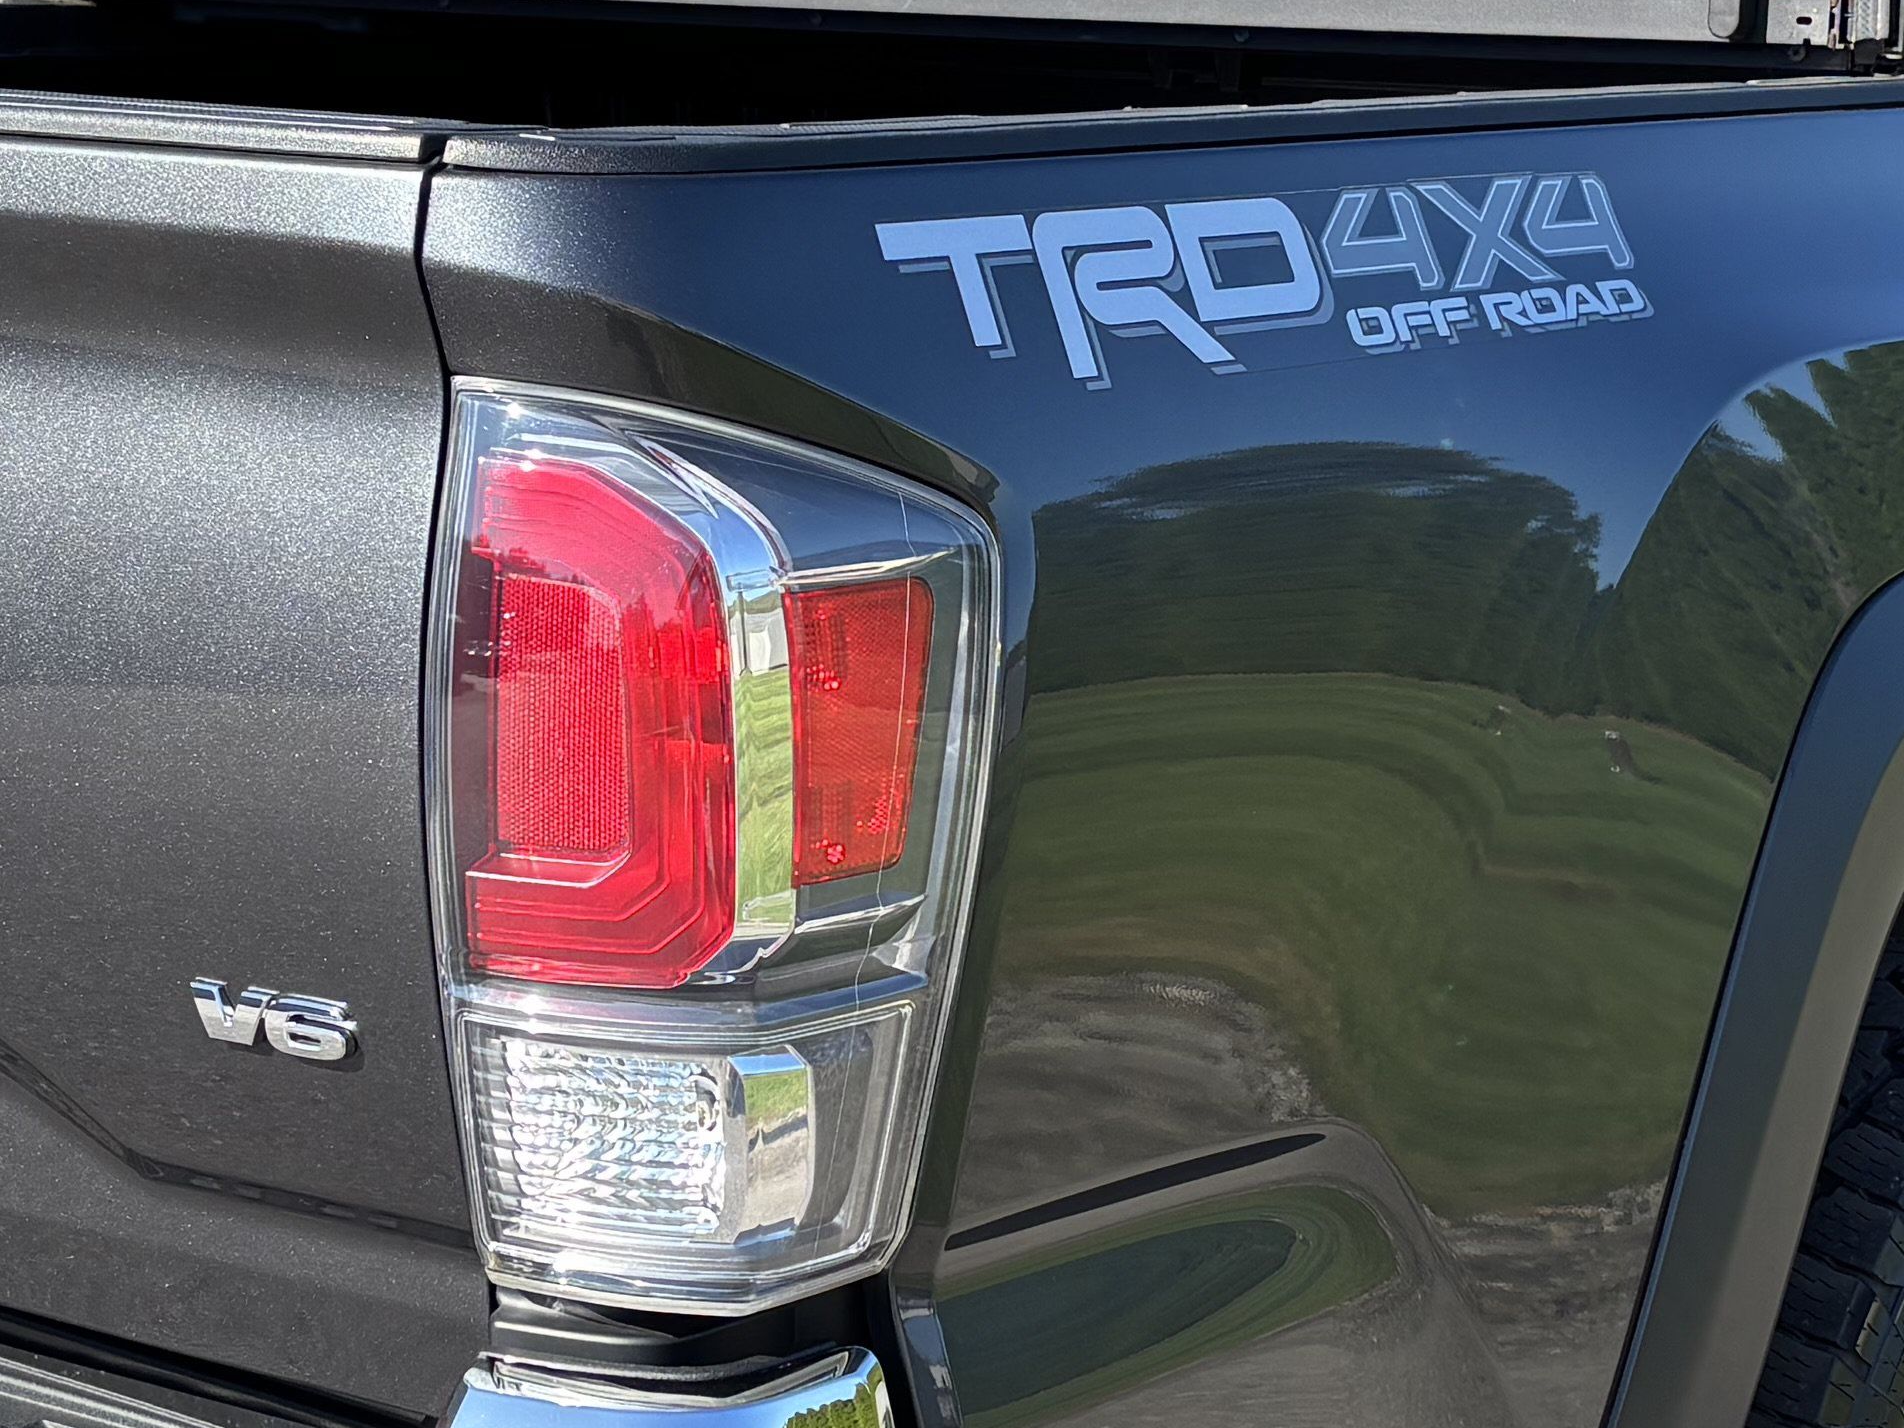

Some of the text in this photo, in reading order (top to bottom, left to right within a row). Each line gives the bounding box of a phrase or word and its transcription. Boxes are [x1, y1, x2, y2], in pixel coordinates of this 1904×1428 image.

[874, 196, 1334, 390] TRD
[1346, 278, 1654, 355] OFF ROAD
[190, 976, 361, 1061] V6
